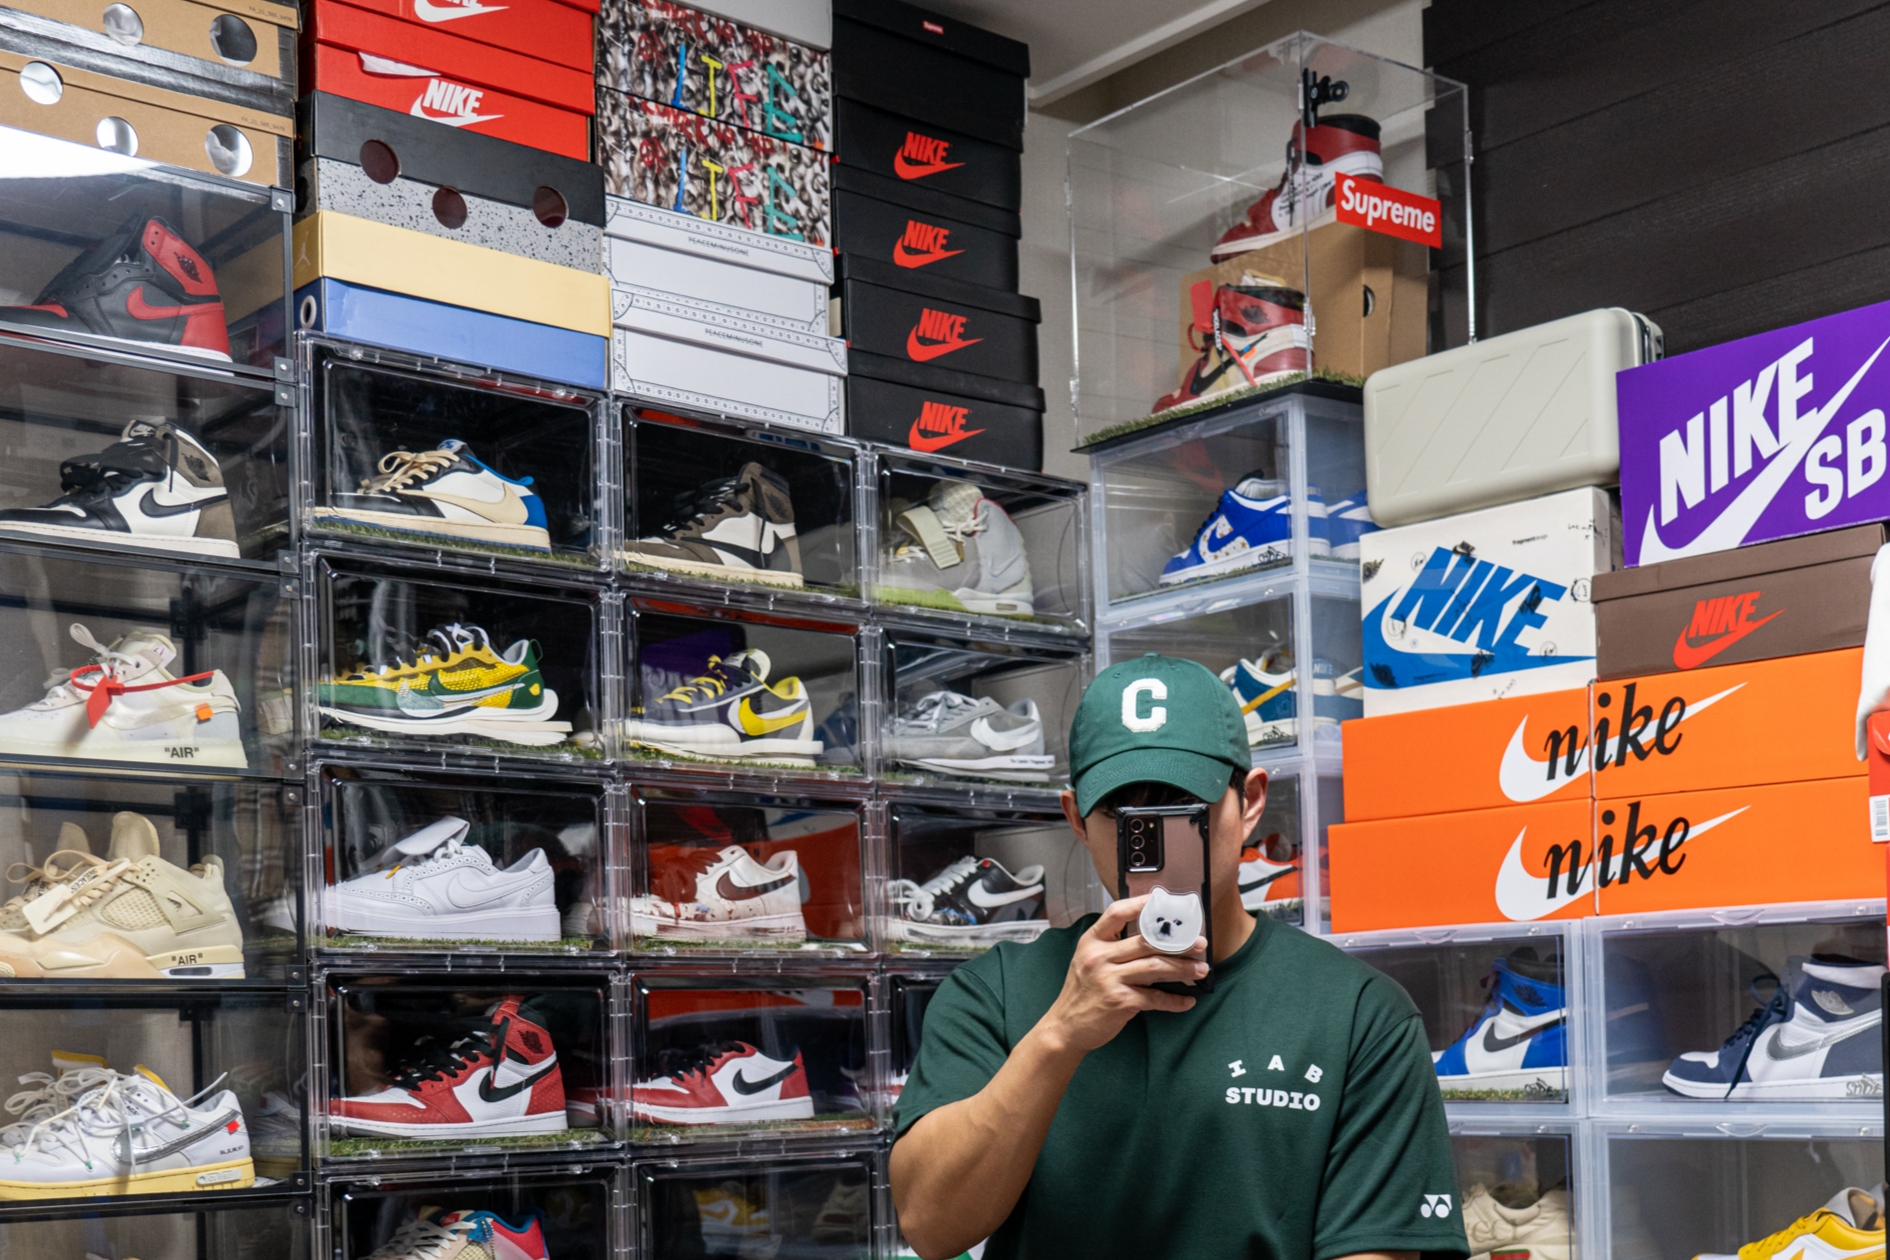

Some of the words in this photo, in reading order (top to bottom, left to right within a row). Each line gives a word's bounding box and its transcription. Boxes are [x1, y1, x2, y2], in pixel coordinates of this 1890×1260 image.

[422, 78, 484, 117] NIKE
[903, 131, 950, 165] NIKE
[1341, 178, 1435, 233] Supreme
[903, 219, 950, 253] NIKE
[917, 307, 967, 341] NIKE
[918, 401, 969, 434] NIKE
[1658, 336, 1816, 528] NIKE
[1804, 408, 1888, 520] SB
[1390, 546, 1568, 656] NIKE
[1686, 590, 1761, 640] NIKE
[1122, 678, 1168, 732] C
[164, 746, 200, 759] "AIR"
[1543, 682, 1687, 782] nike
[1543, 801, 1691, 900] nike
[171, 953, 203, 966] "AIR"
[1225, 1086, 1321, 1111] STUDIO
